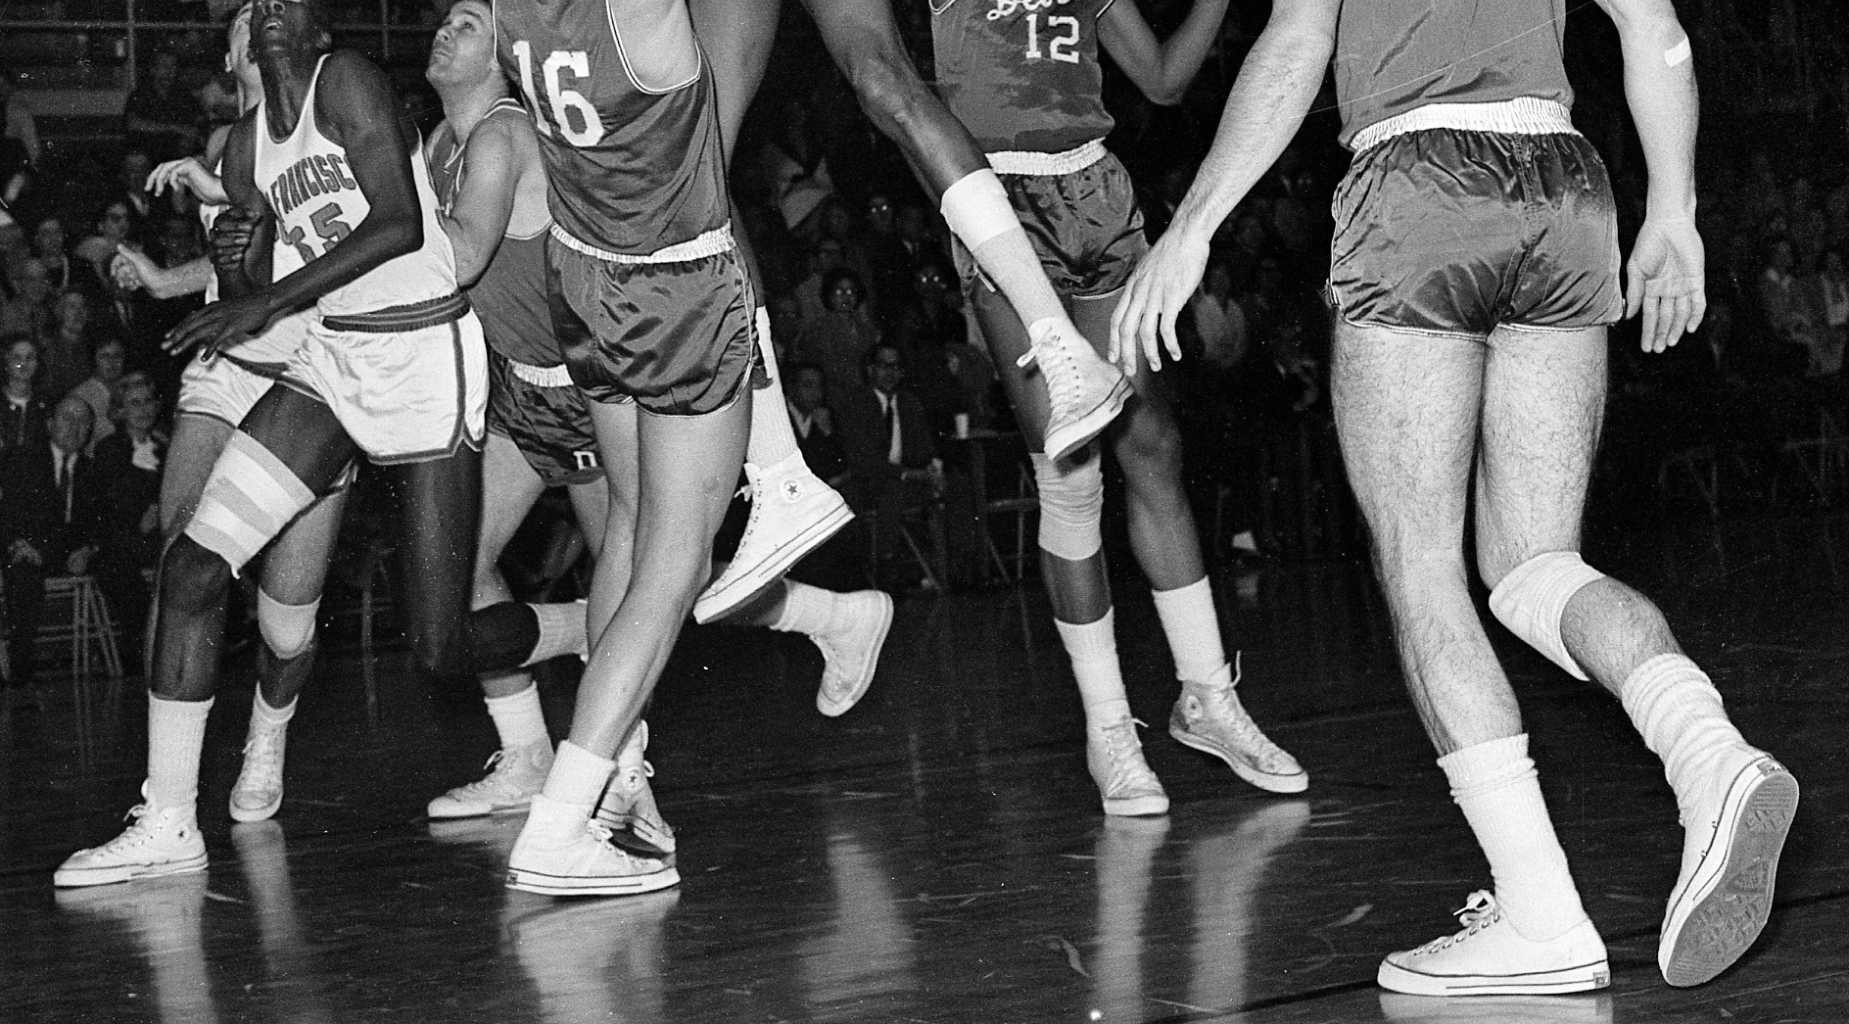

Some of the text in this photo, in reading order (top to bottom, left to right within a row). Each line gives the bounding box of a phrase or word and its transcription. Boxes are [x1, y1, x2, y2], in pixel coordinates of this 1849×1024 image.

[1025, 13, 1080, 64] 12
[511, 39, 605, 148] 16
[269, 153, 357, 225] FRANCISC
[281, 202, 352, 264] 15
